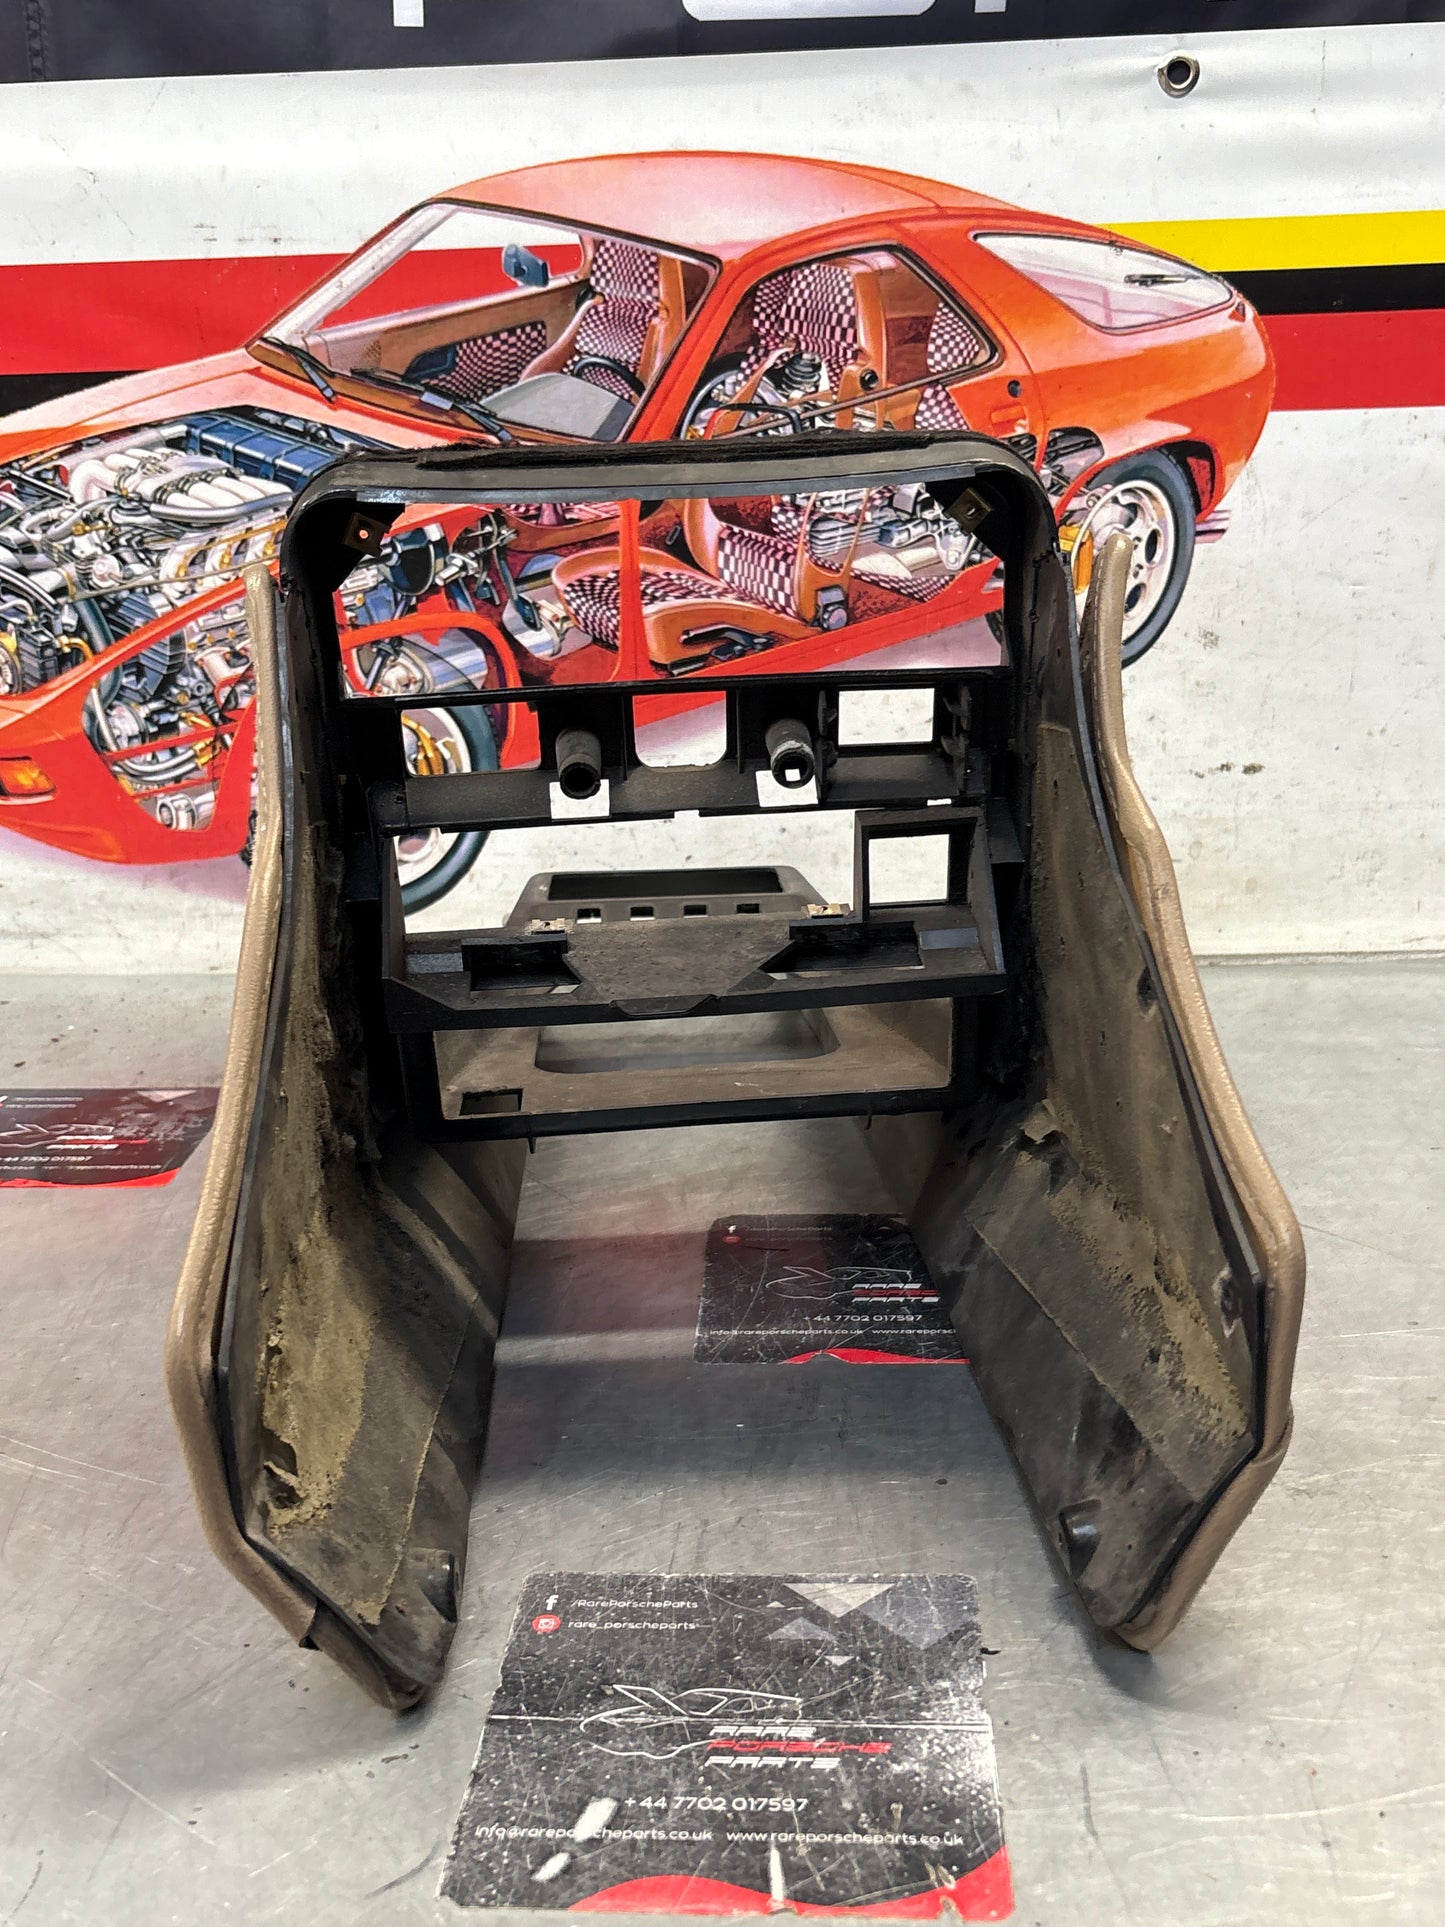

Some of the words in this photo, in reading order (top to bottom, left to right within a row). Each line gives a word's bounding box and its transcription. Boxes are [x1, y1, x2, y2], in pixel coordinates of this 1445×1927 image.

[834, 1314, 871, 1322] 7702
[872, 1314, 923, 1322] 017597
[709, 1725, 817, 1738] RARE
[706, 1739, 893, 1754] PORSCHE
[704, 1755, 841, 1769] PARTS
[673, 1796, 727, 1812] 7702
[732, 1797, 809, 1812] 017597
[474, 1823, 714, 1841] info@rarepocheparts.co.uk
[726, 1830, 965, 1846] www.rareporscheparts.co.uk
